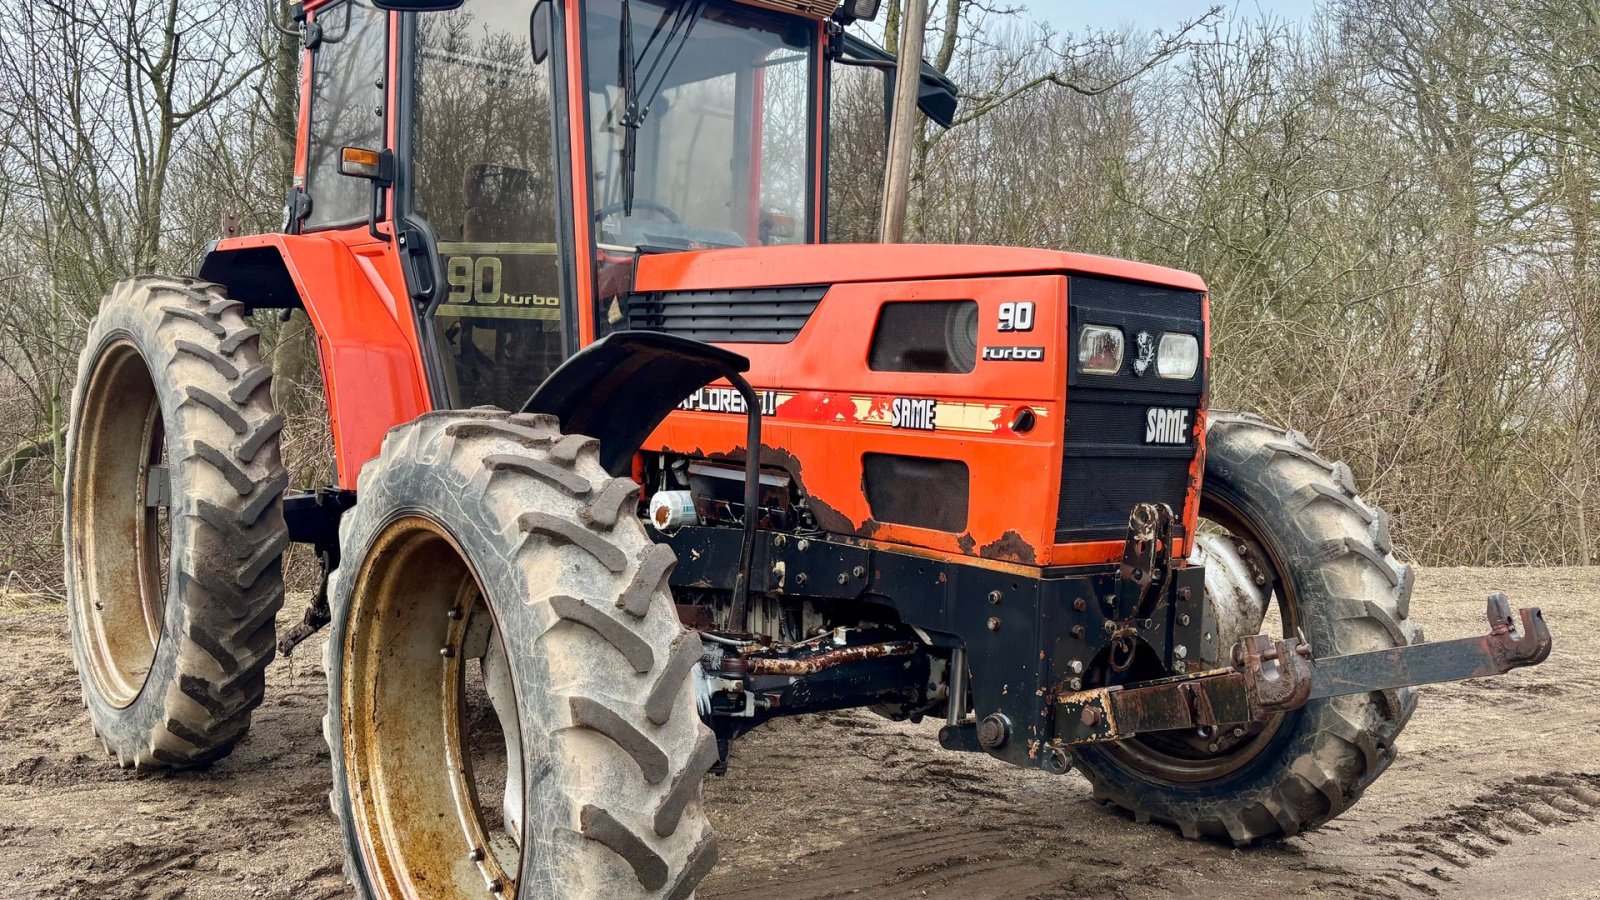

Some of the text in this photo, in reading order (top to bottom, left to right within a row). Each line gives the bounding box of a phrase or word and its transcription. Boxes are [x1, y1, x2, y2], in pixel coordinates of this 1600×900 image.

[448, 256, 559, 305] 90 turbo
[998, 301, 1034, 331] 90
[982, 346, 1043, 361] turbo
[892, 398, 935, 428] SAME
[1145, 408, 1188, 444] SAME
